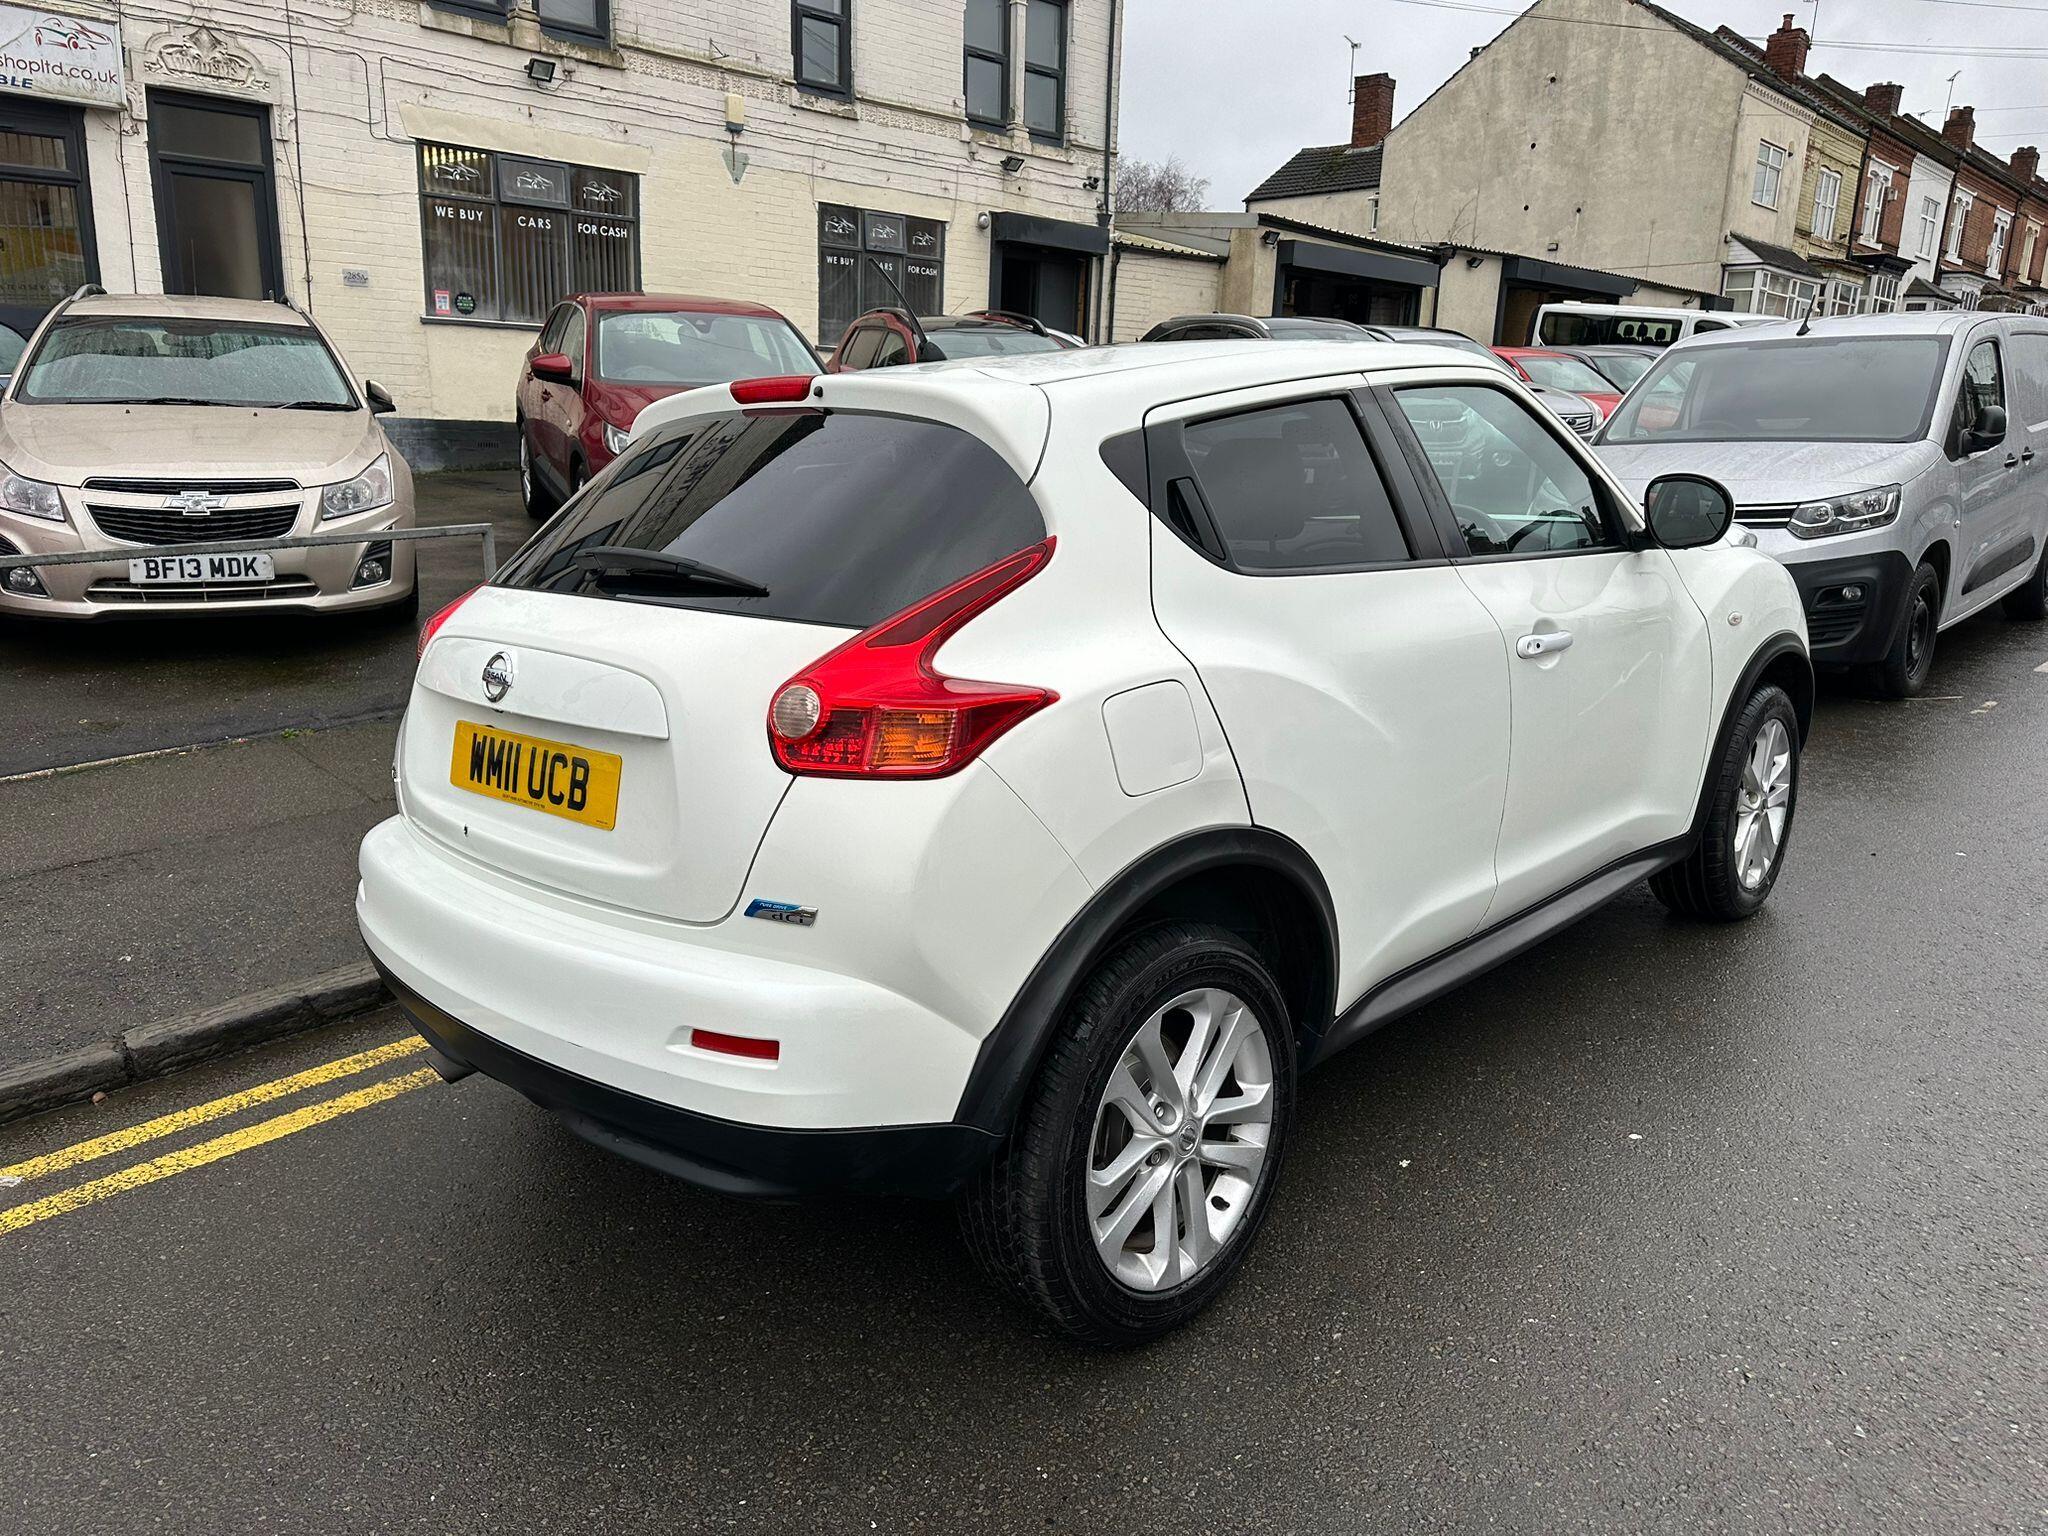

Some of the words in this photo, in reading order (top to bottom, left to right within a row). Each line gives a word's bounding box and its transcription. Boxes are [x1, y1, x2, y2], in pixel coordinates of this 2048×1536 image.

[435, 205, 454, 219] WE
[459, 209, 484, 222] BUY
[517, 216, 552, 230] CARS
[577, 223, 598, 235] FOR
[600, 225, 627, 239] CASH
[826, 255, 838, 265] WE
[840, 257, 855, 267] BUY
[907, 265, 920, 274] FOR
[920, 266, 938, 277] CASH
[143, 558, 202, 580] BF13
[209, 556, 259, 578] MDK
[469, 732, 522, 794] WM11
[527, 746, 590, 812] UCB
